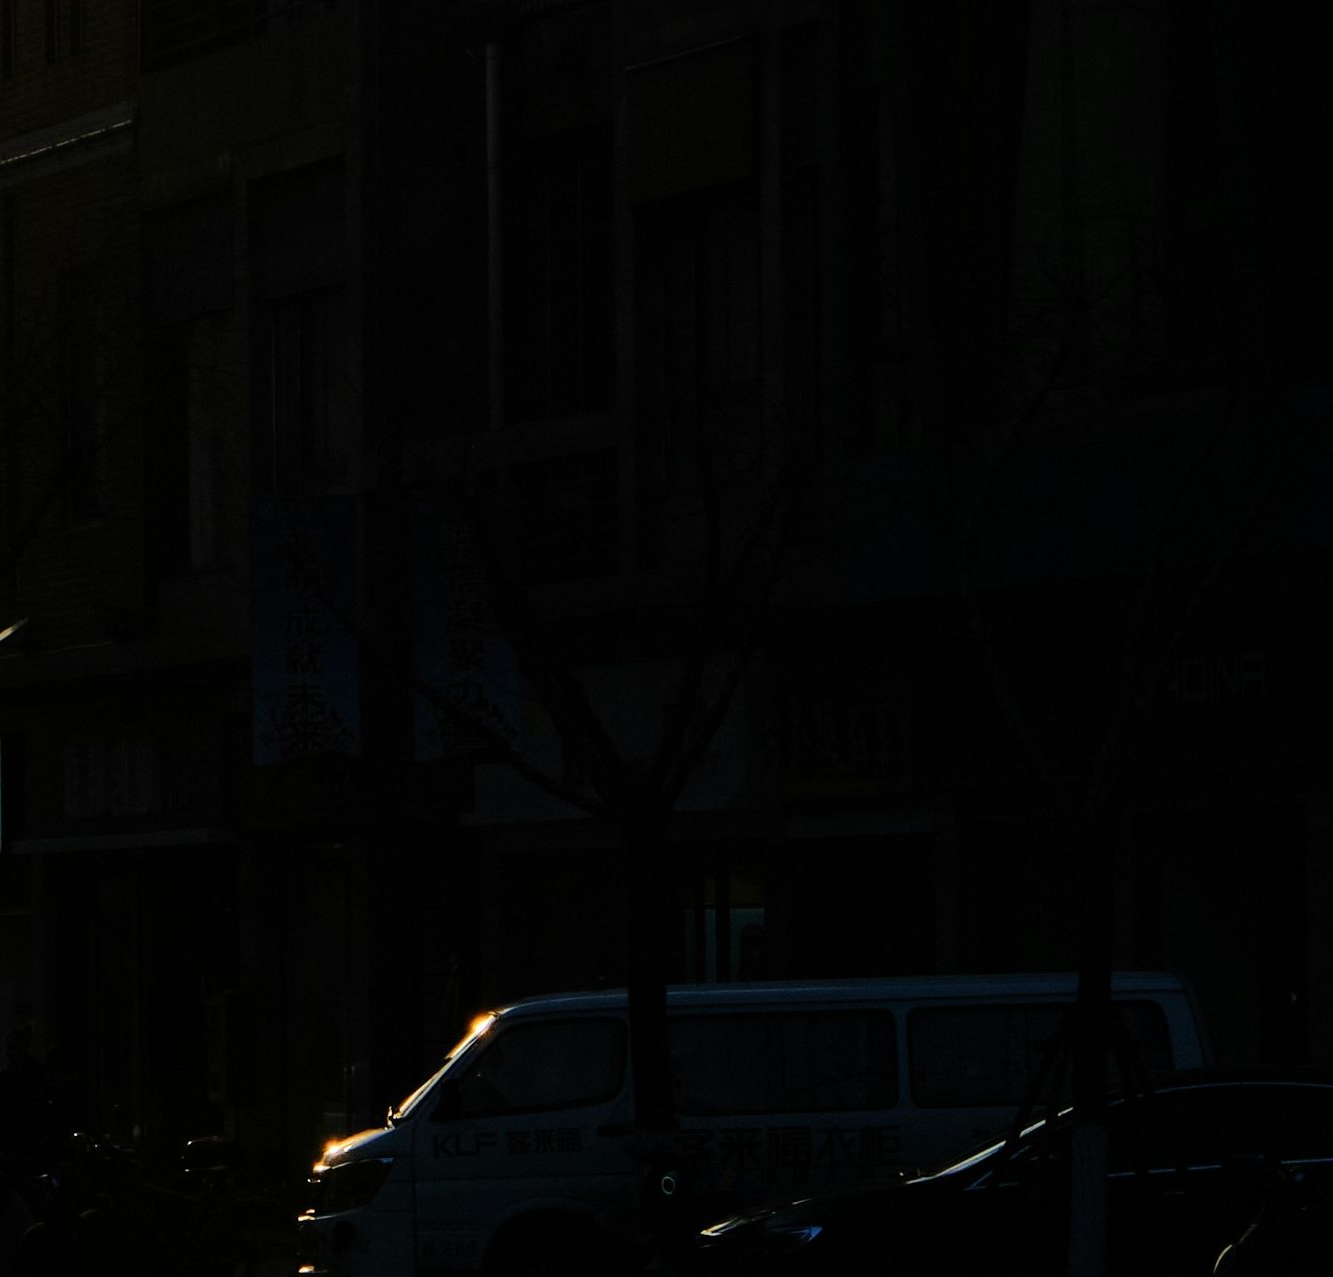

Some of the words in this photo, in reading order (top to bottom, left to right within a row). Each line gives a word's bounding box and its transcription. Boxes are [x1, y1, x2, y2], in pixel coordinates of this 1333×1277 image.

[432, 1132, 496, 1158] KLF
[505, 1126, 582, 1155] 客来福
